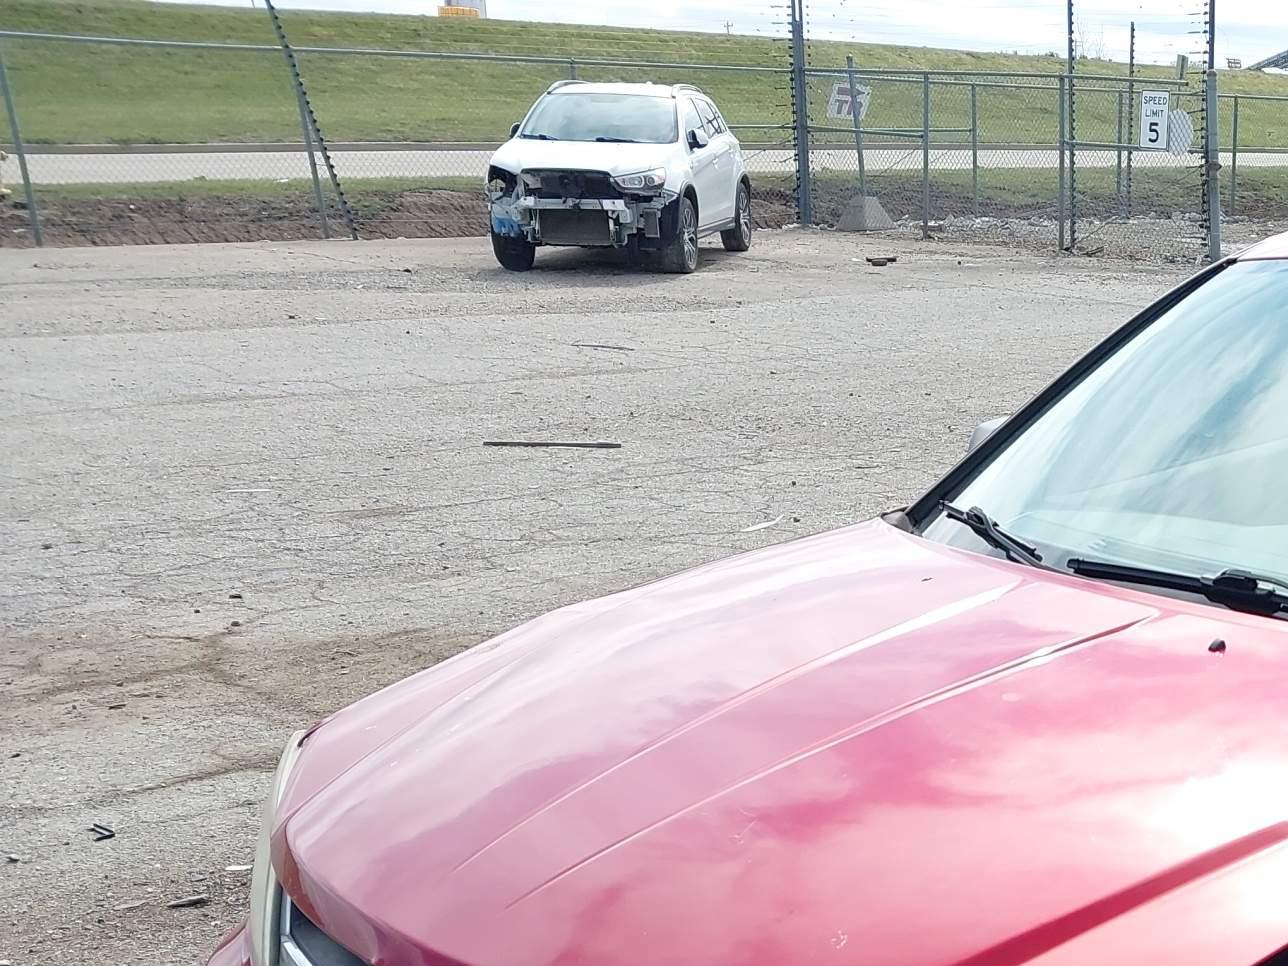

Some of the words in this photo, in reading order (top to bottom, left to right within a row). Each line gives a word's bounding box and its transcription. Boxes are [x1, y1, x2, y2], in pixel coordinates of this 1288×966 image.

[1143, 95, 1168, 106] SPEED
[1145, 108, 1165, 118] LIMIT
[1148, 122, 1160, 143] 5
